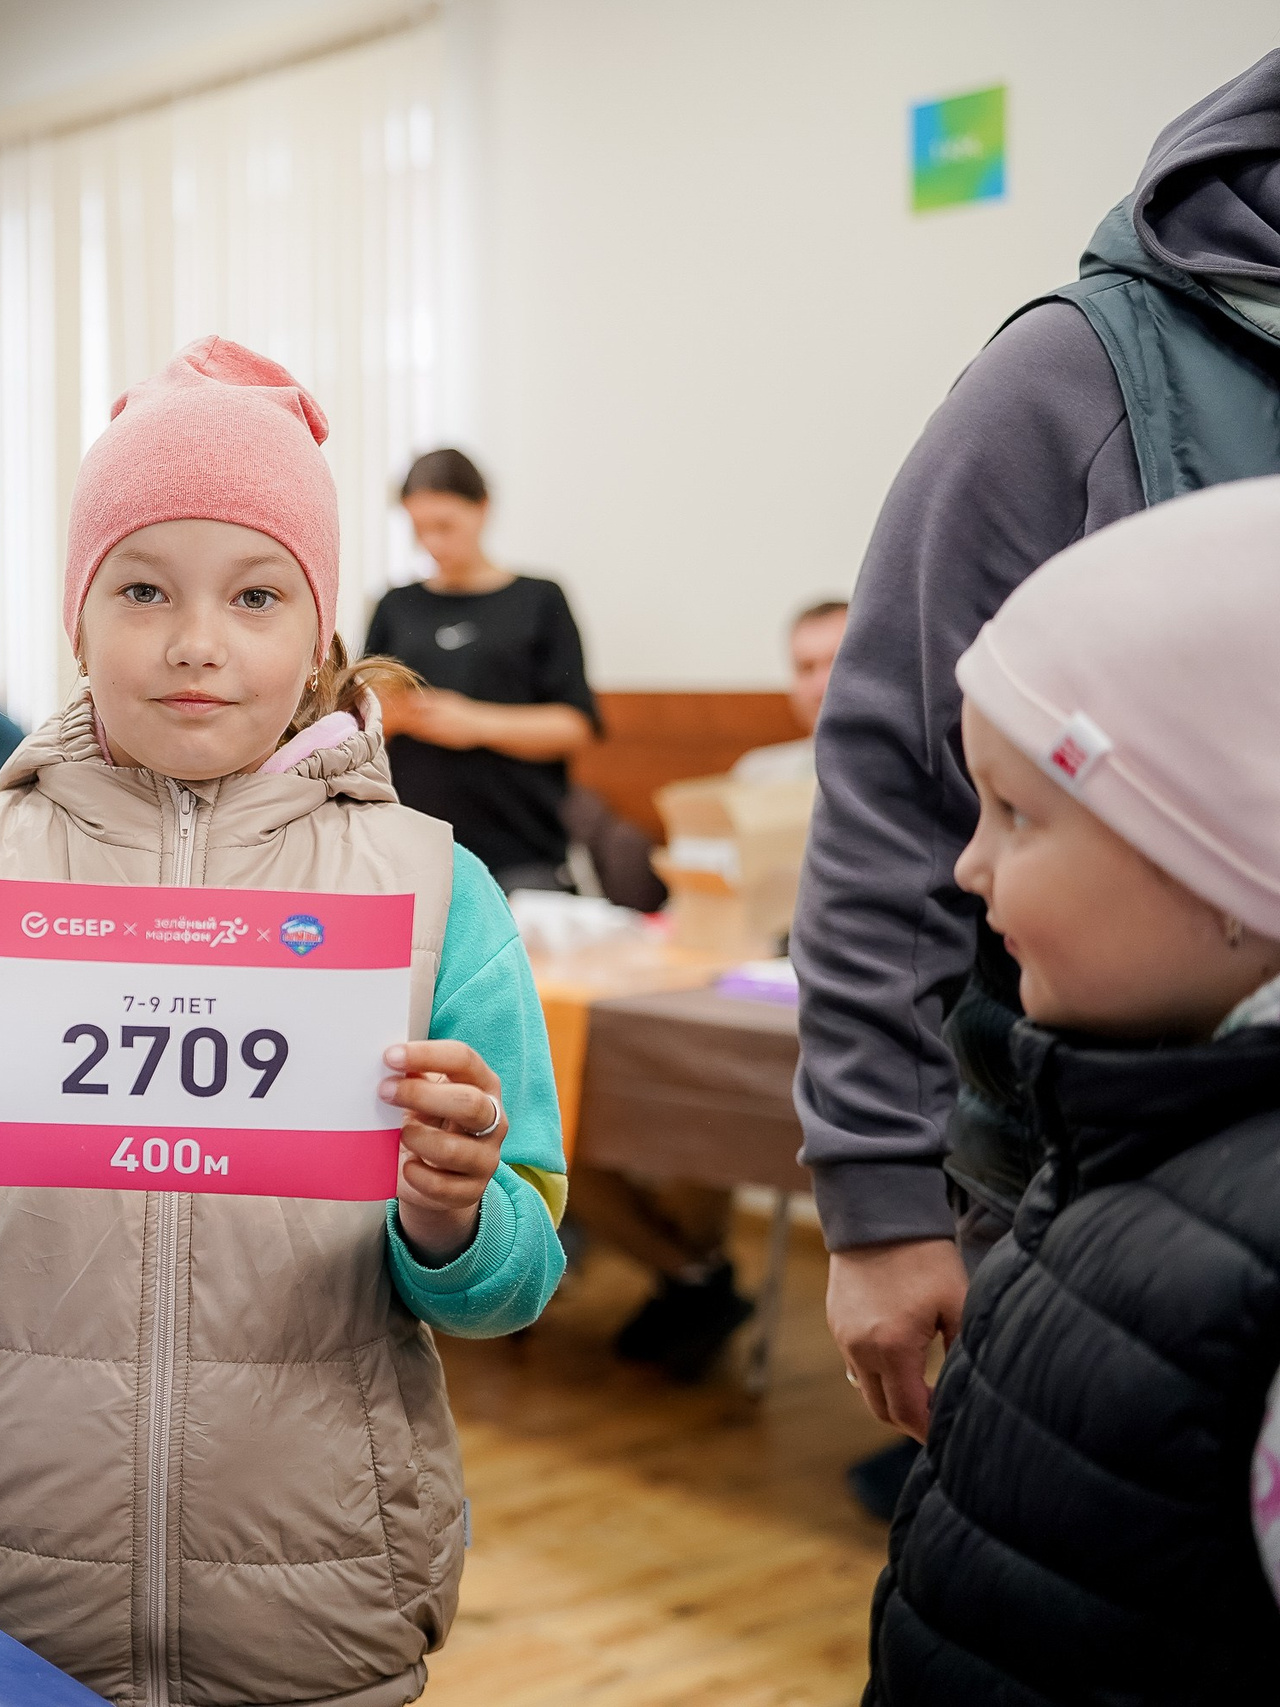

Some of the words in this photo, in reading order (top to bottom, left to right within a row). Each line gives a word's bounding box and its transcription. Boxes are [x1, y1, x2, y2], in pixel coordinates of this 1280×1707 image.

[53, 917, 116, 937] СБЕР
[154, 916, 217, 930] зелёный
[145, 929, 212, 944] марафон
[123, 995, 160, 1013] 7-9
[169, 997, 217, 1014] ЛЕТ
[61, 1023, 289, 1099] 2709
